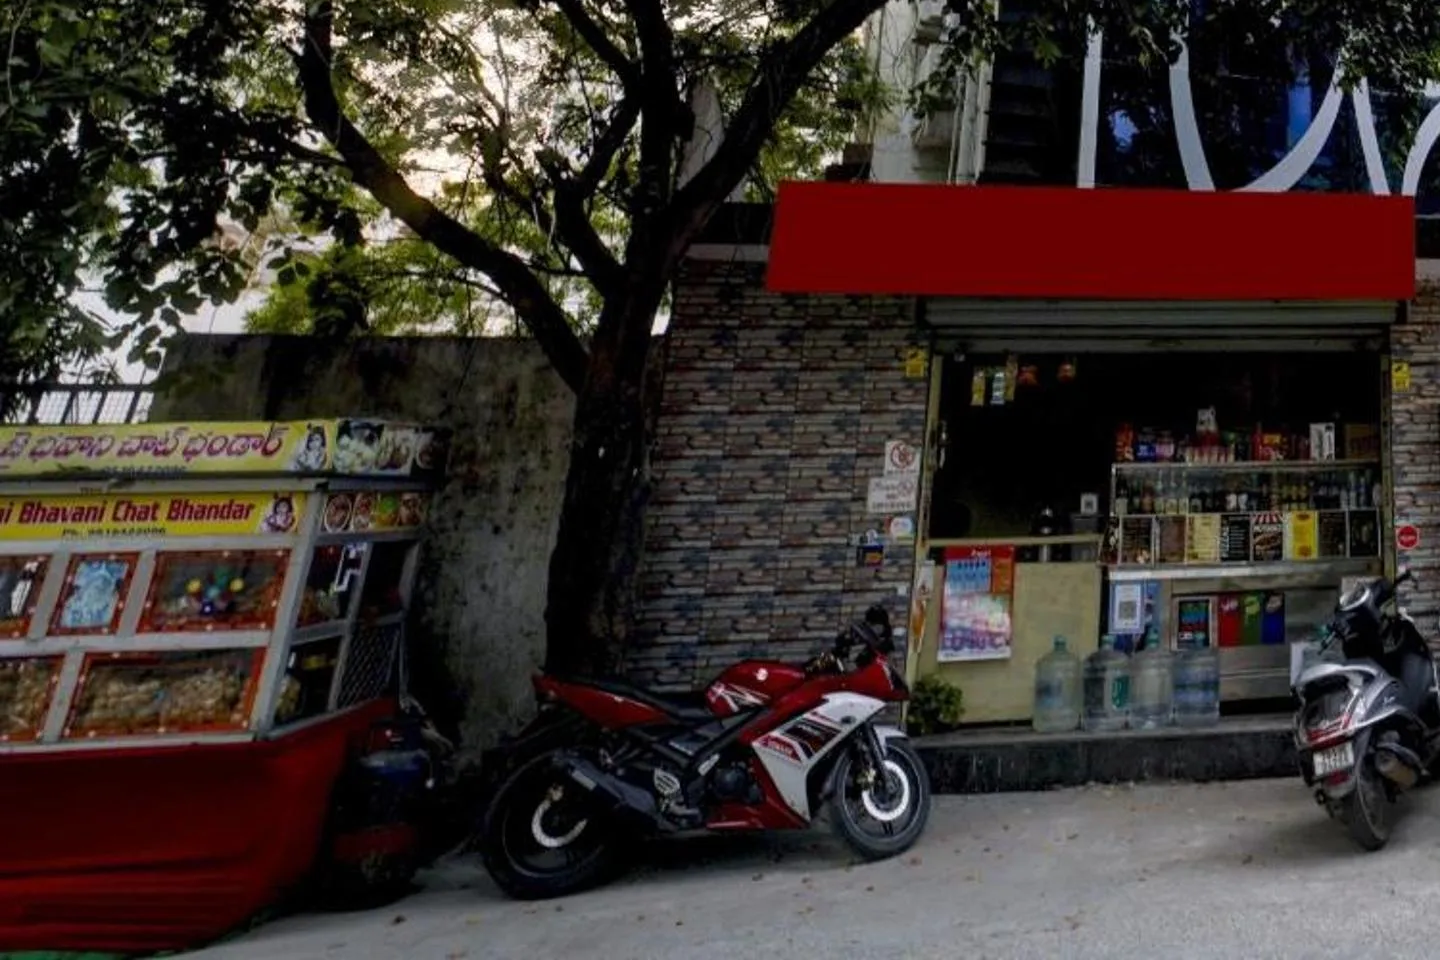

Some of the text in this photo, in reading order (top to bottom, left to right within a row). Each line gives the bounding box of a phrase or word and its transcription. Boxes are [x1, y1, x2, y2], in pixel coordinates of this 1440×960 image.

[19, 499, 108, 524] Bhavani
[112, 499, 160, 523] Chat
[167, 497, 256, 522] Bhandar
